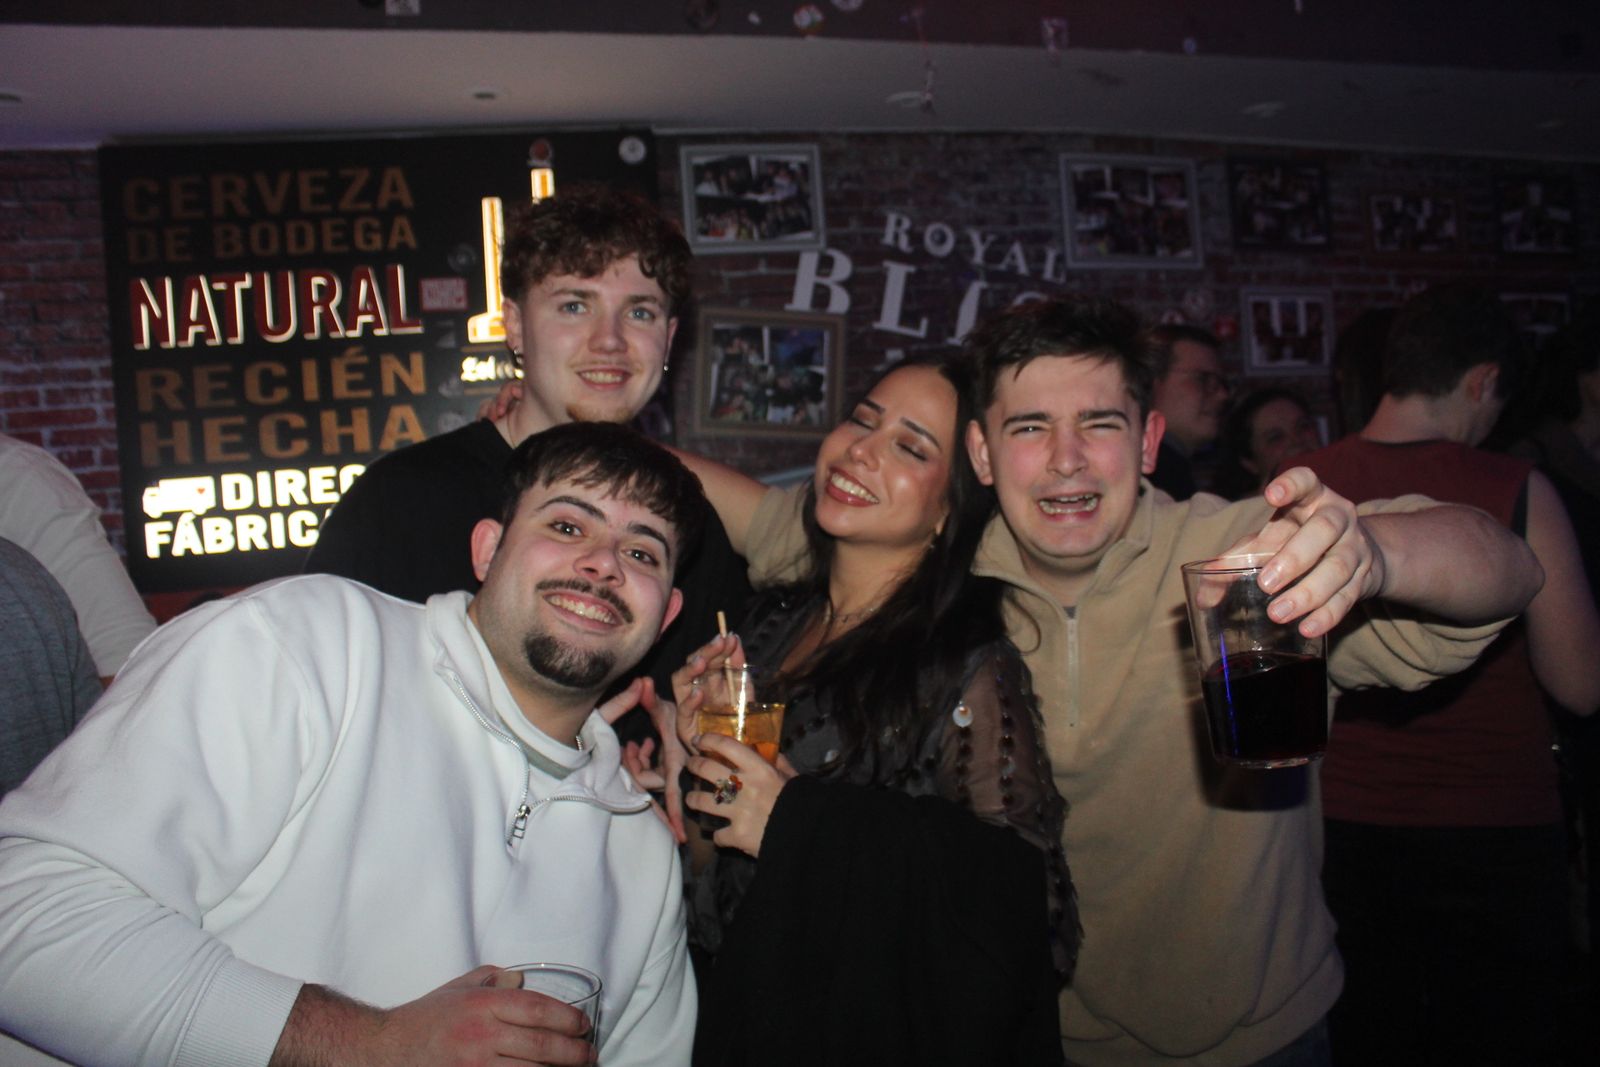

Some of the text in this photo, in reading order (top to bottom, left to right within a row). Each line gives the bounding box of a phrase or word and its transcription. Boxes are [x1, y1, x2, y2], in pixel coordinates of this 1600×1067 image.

[122, 165, 414, 221] CERVEZA
[126, 214, 418, 265] DE BODEGA
[880, 210, 1066, 285] ROYAL
[129, 264, 424, 350] NATURAL
[135, 345, 427, 412] RECIÉN
[139, 404, 426, 467] HECHA
[145, 511, 332, 559] FÁBRIC
